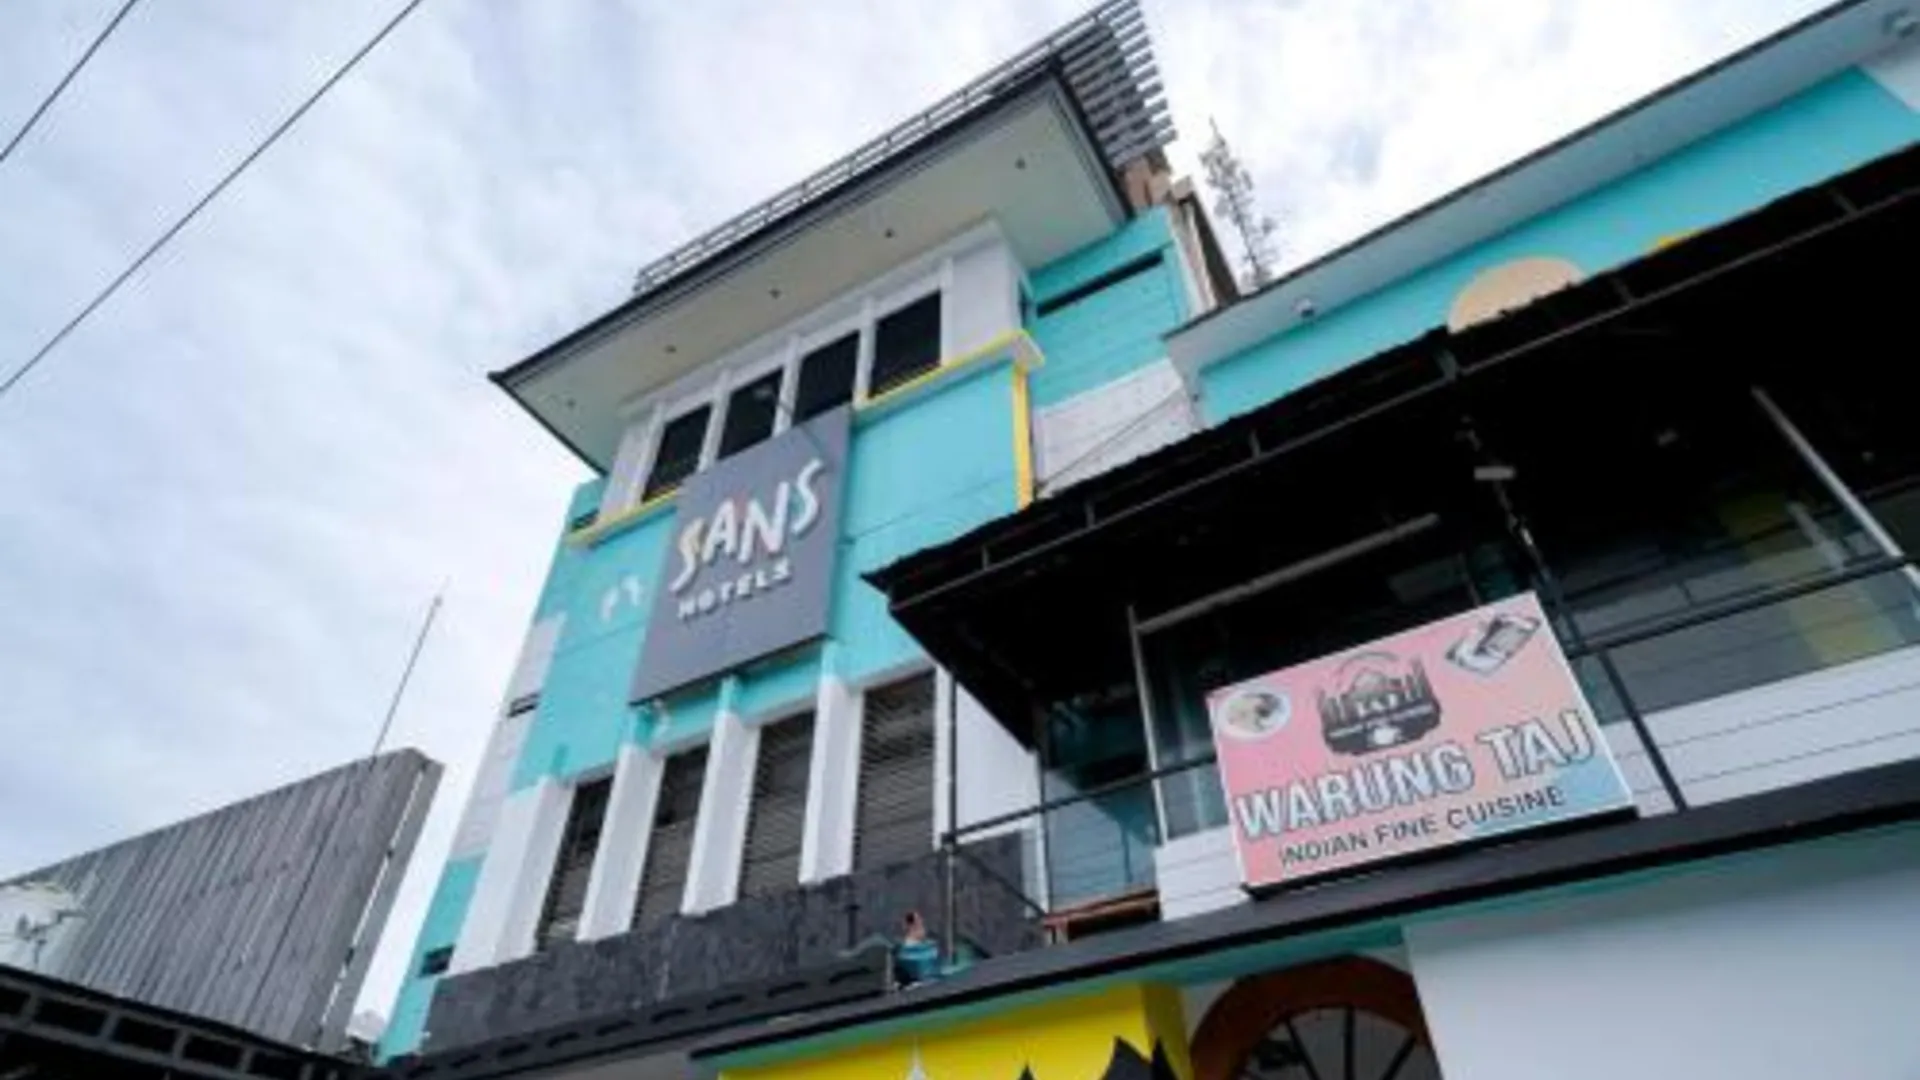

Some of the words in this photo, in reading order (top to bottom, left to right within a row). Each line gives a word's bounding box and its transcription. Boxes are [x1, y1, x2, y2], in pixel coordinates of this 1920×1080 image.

[669, 458, 822, 593] SANS
[677, 556, 791, 620] HOTELS
[1238, 743, 1474, 840] WARUNG
[1477, 708, 1595, 779] TAJ
[1280, 831, 1369, 866] INDIAN
[1375, 813, 1438, 845] FINE
[1446, 786, 1563, 830] CUISINE
